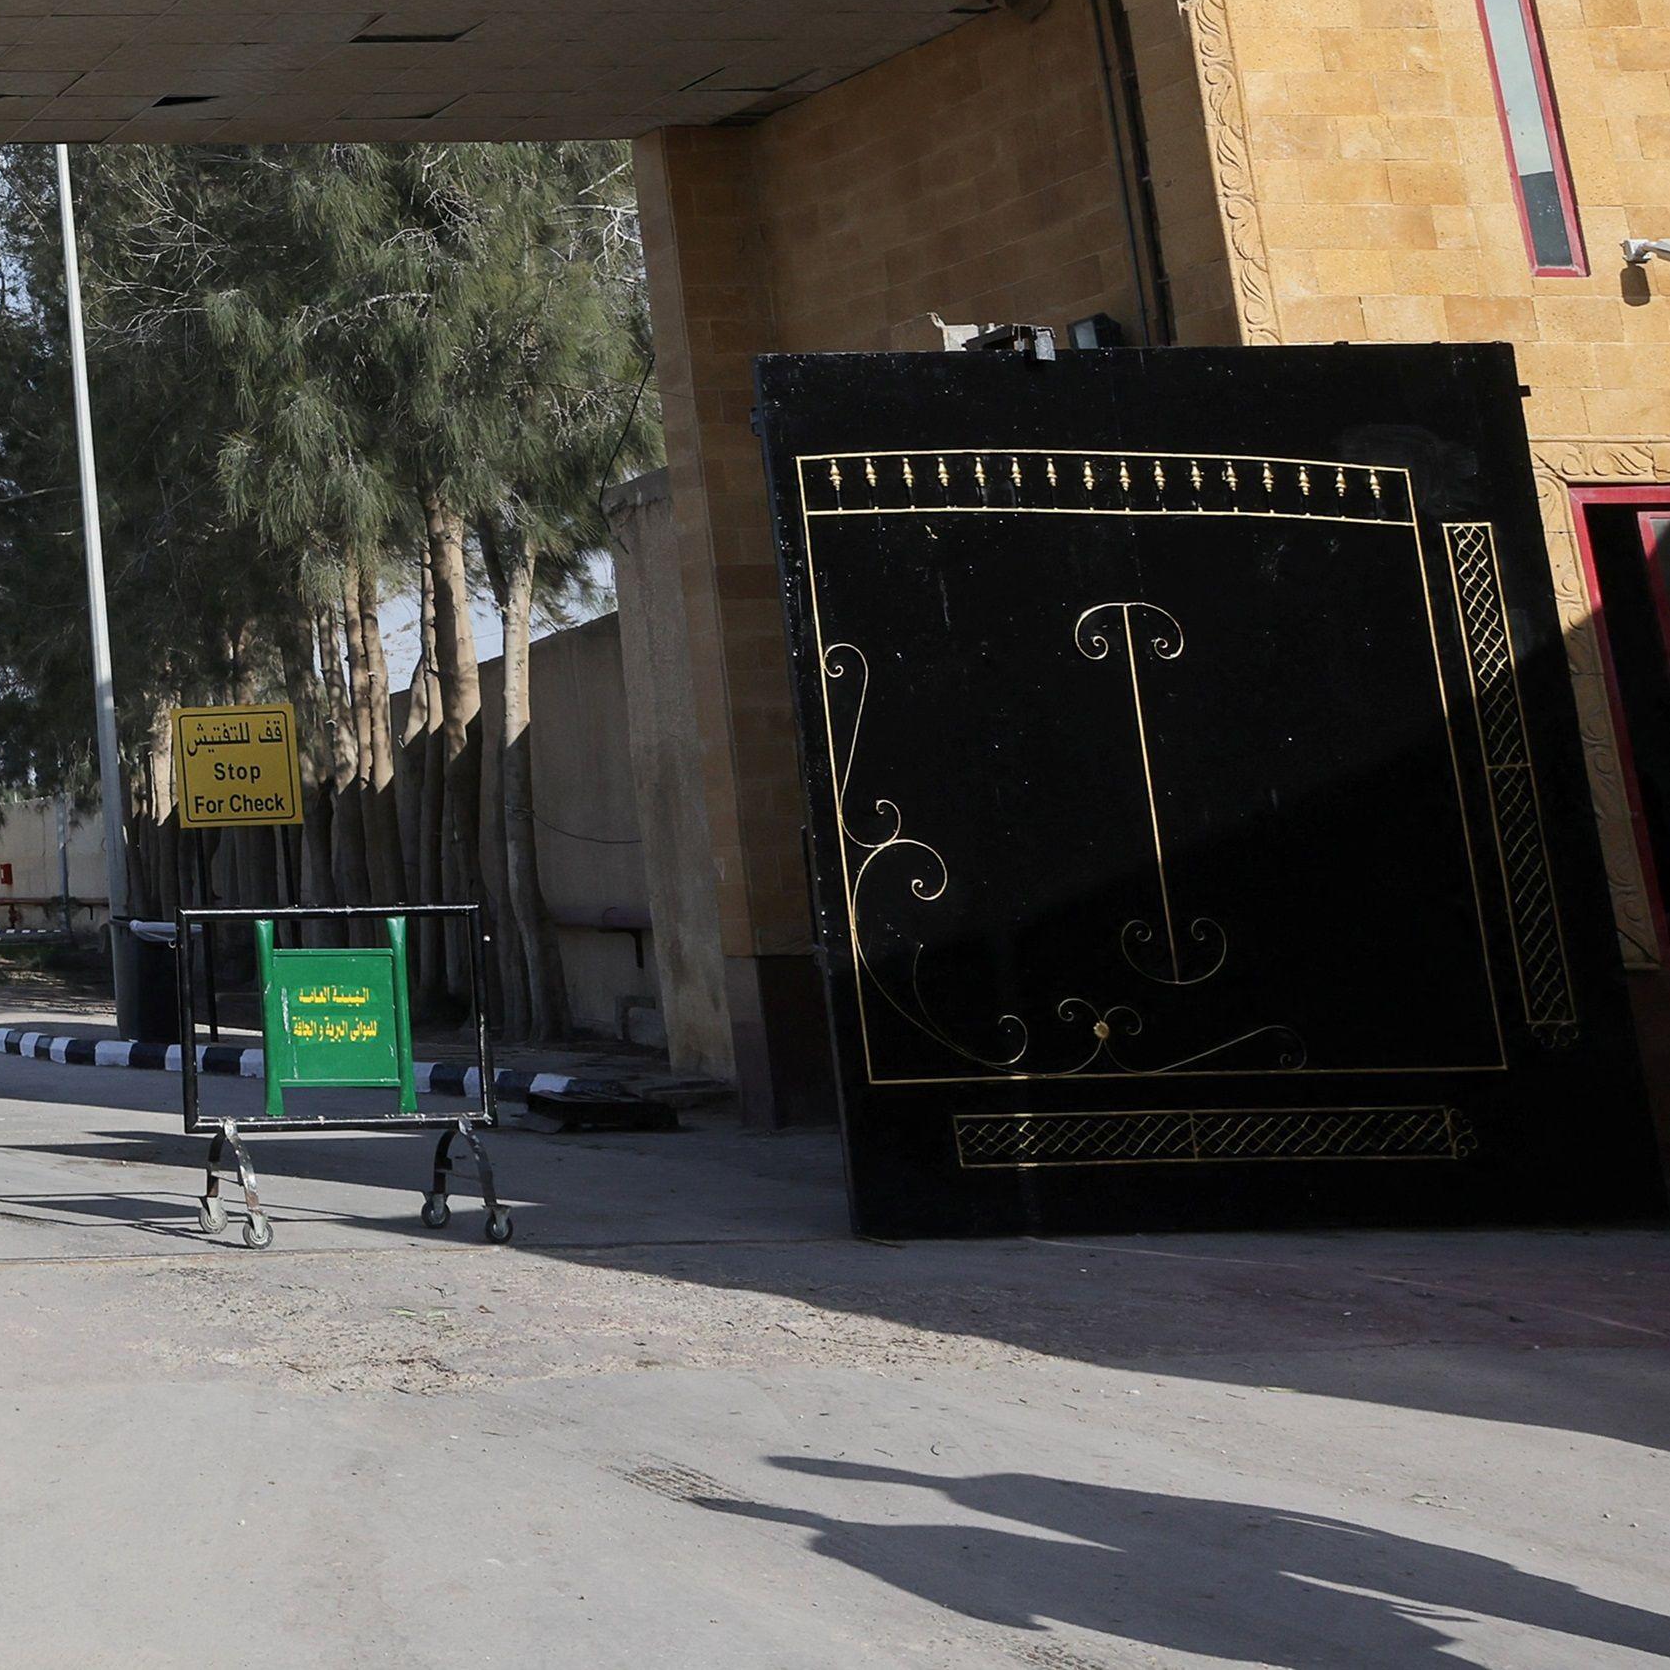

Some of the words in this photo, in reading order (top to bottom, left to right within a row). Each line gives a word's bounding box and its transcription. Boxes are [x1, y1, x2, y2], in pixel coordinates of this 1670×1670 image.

[187, 722, 250, 757] للتفتيش
[258, 720, 283, 743] قف
[214, 762, 261, 784] Stop
[194, 795, 224, 814] For
[229, 793, 285, 812] Check
